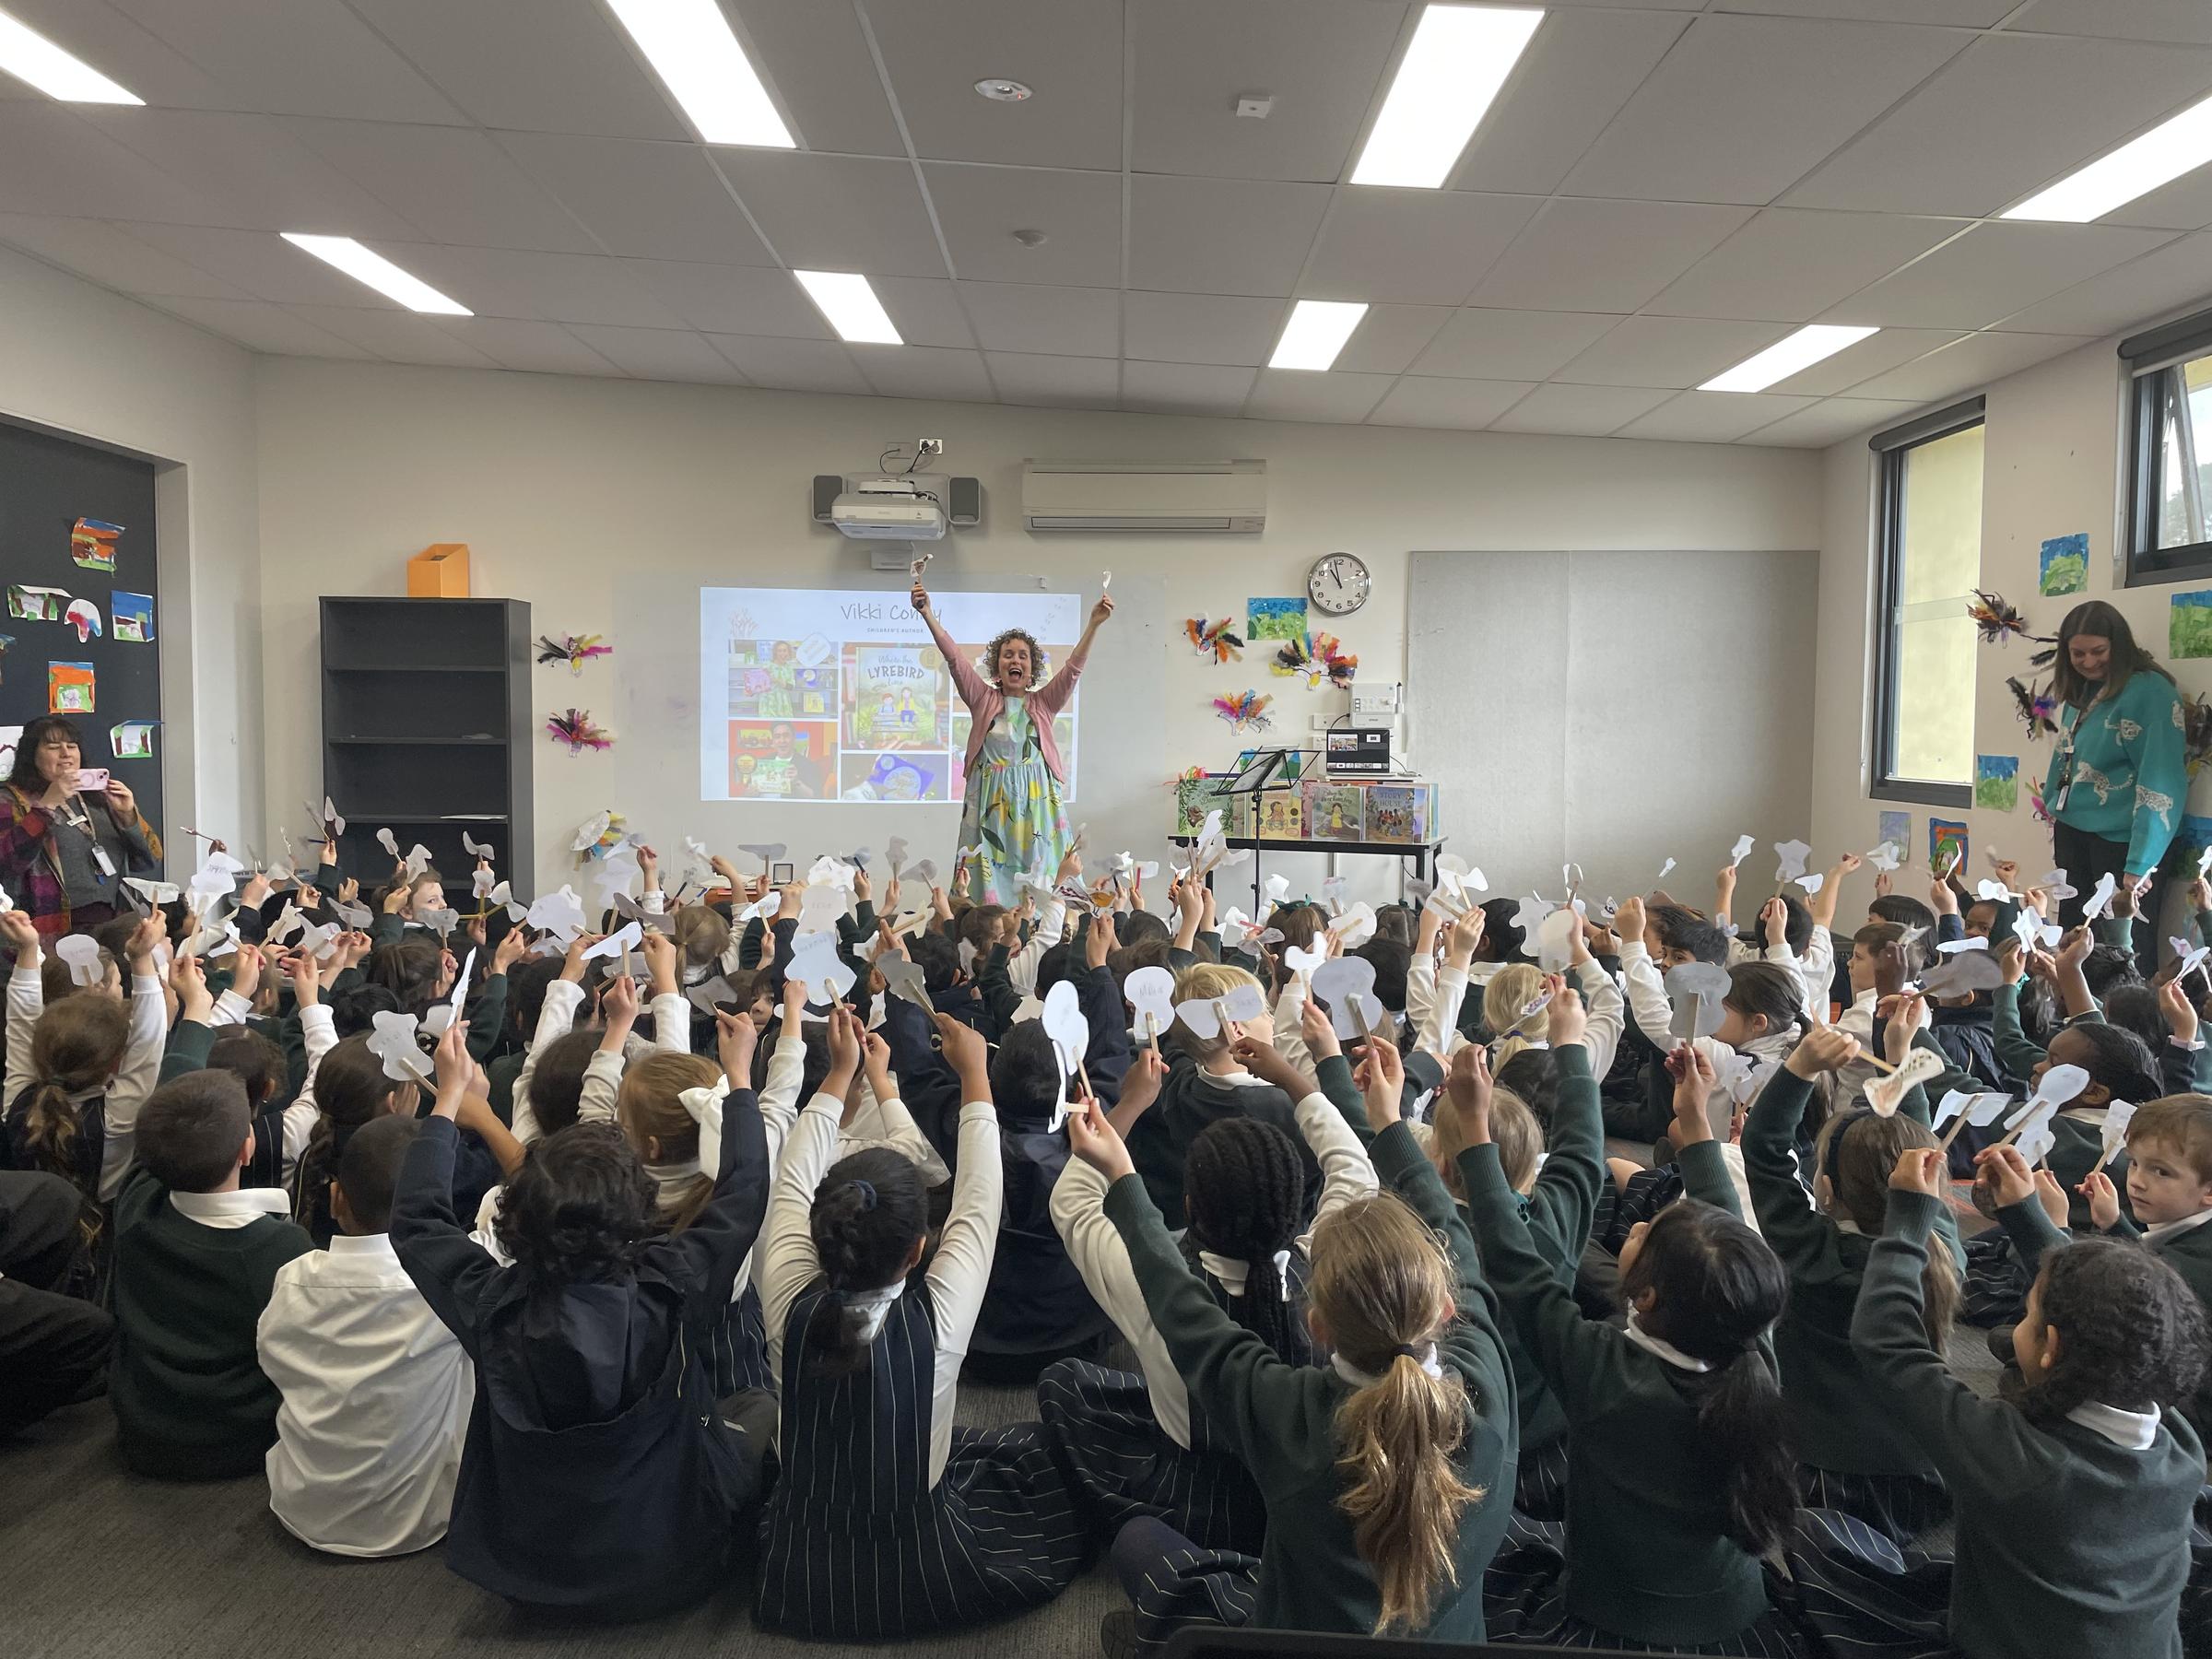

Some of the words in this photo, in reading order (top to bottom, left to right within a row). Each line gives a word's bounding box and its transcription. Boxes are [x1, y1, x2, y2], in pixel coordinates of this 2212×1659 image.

[841, 603, 882, 620] Vikki
[889, 605, 942, 628] Cony
[867, 665, 925, 679] LYREBIRD
